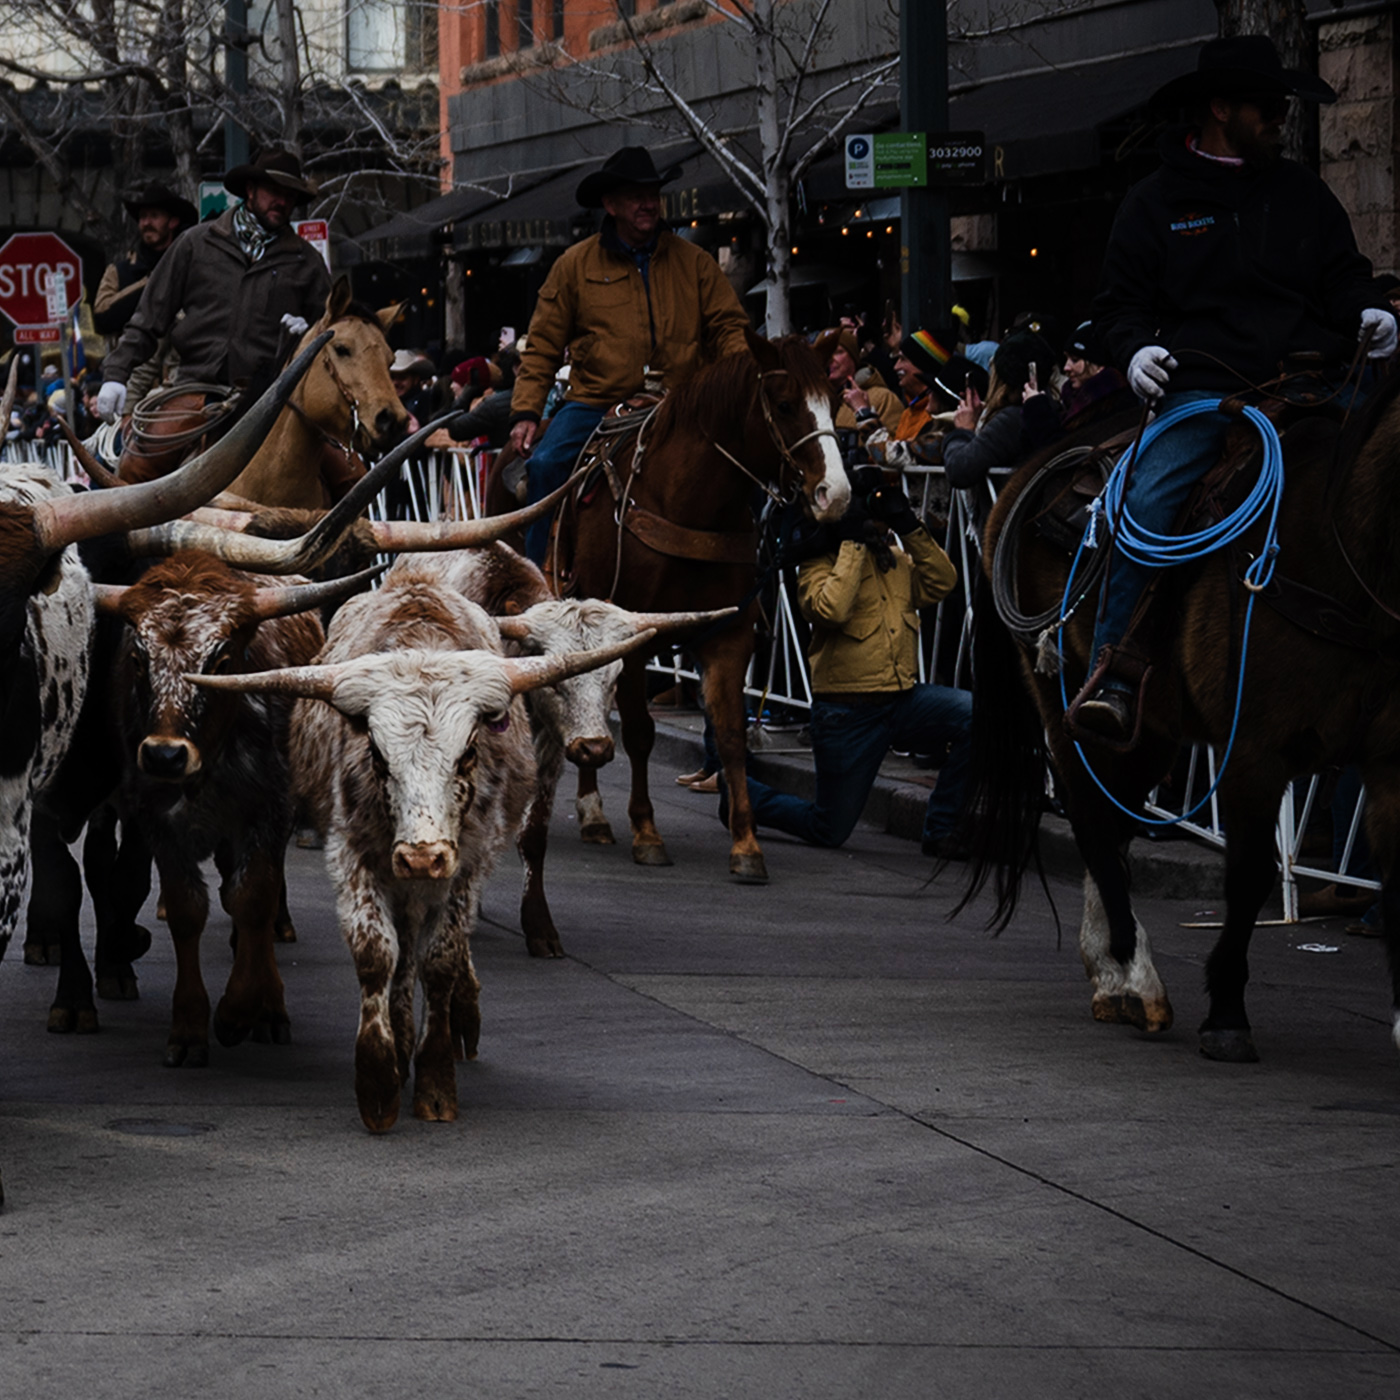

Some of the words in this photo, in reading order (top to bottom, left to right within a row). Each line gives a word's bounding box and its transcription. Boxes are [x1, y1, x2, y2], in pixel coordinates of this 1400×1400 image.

[928, 146, 983, 159] 3032900
[659, 188, 700, 220] NICE
[18, 330, 35, 341] ALL
[39, 329, 57, 340] WAY
